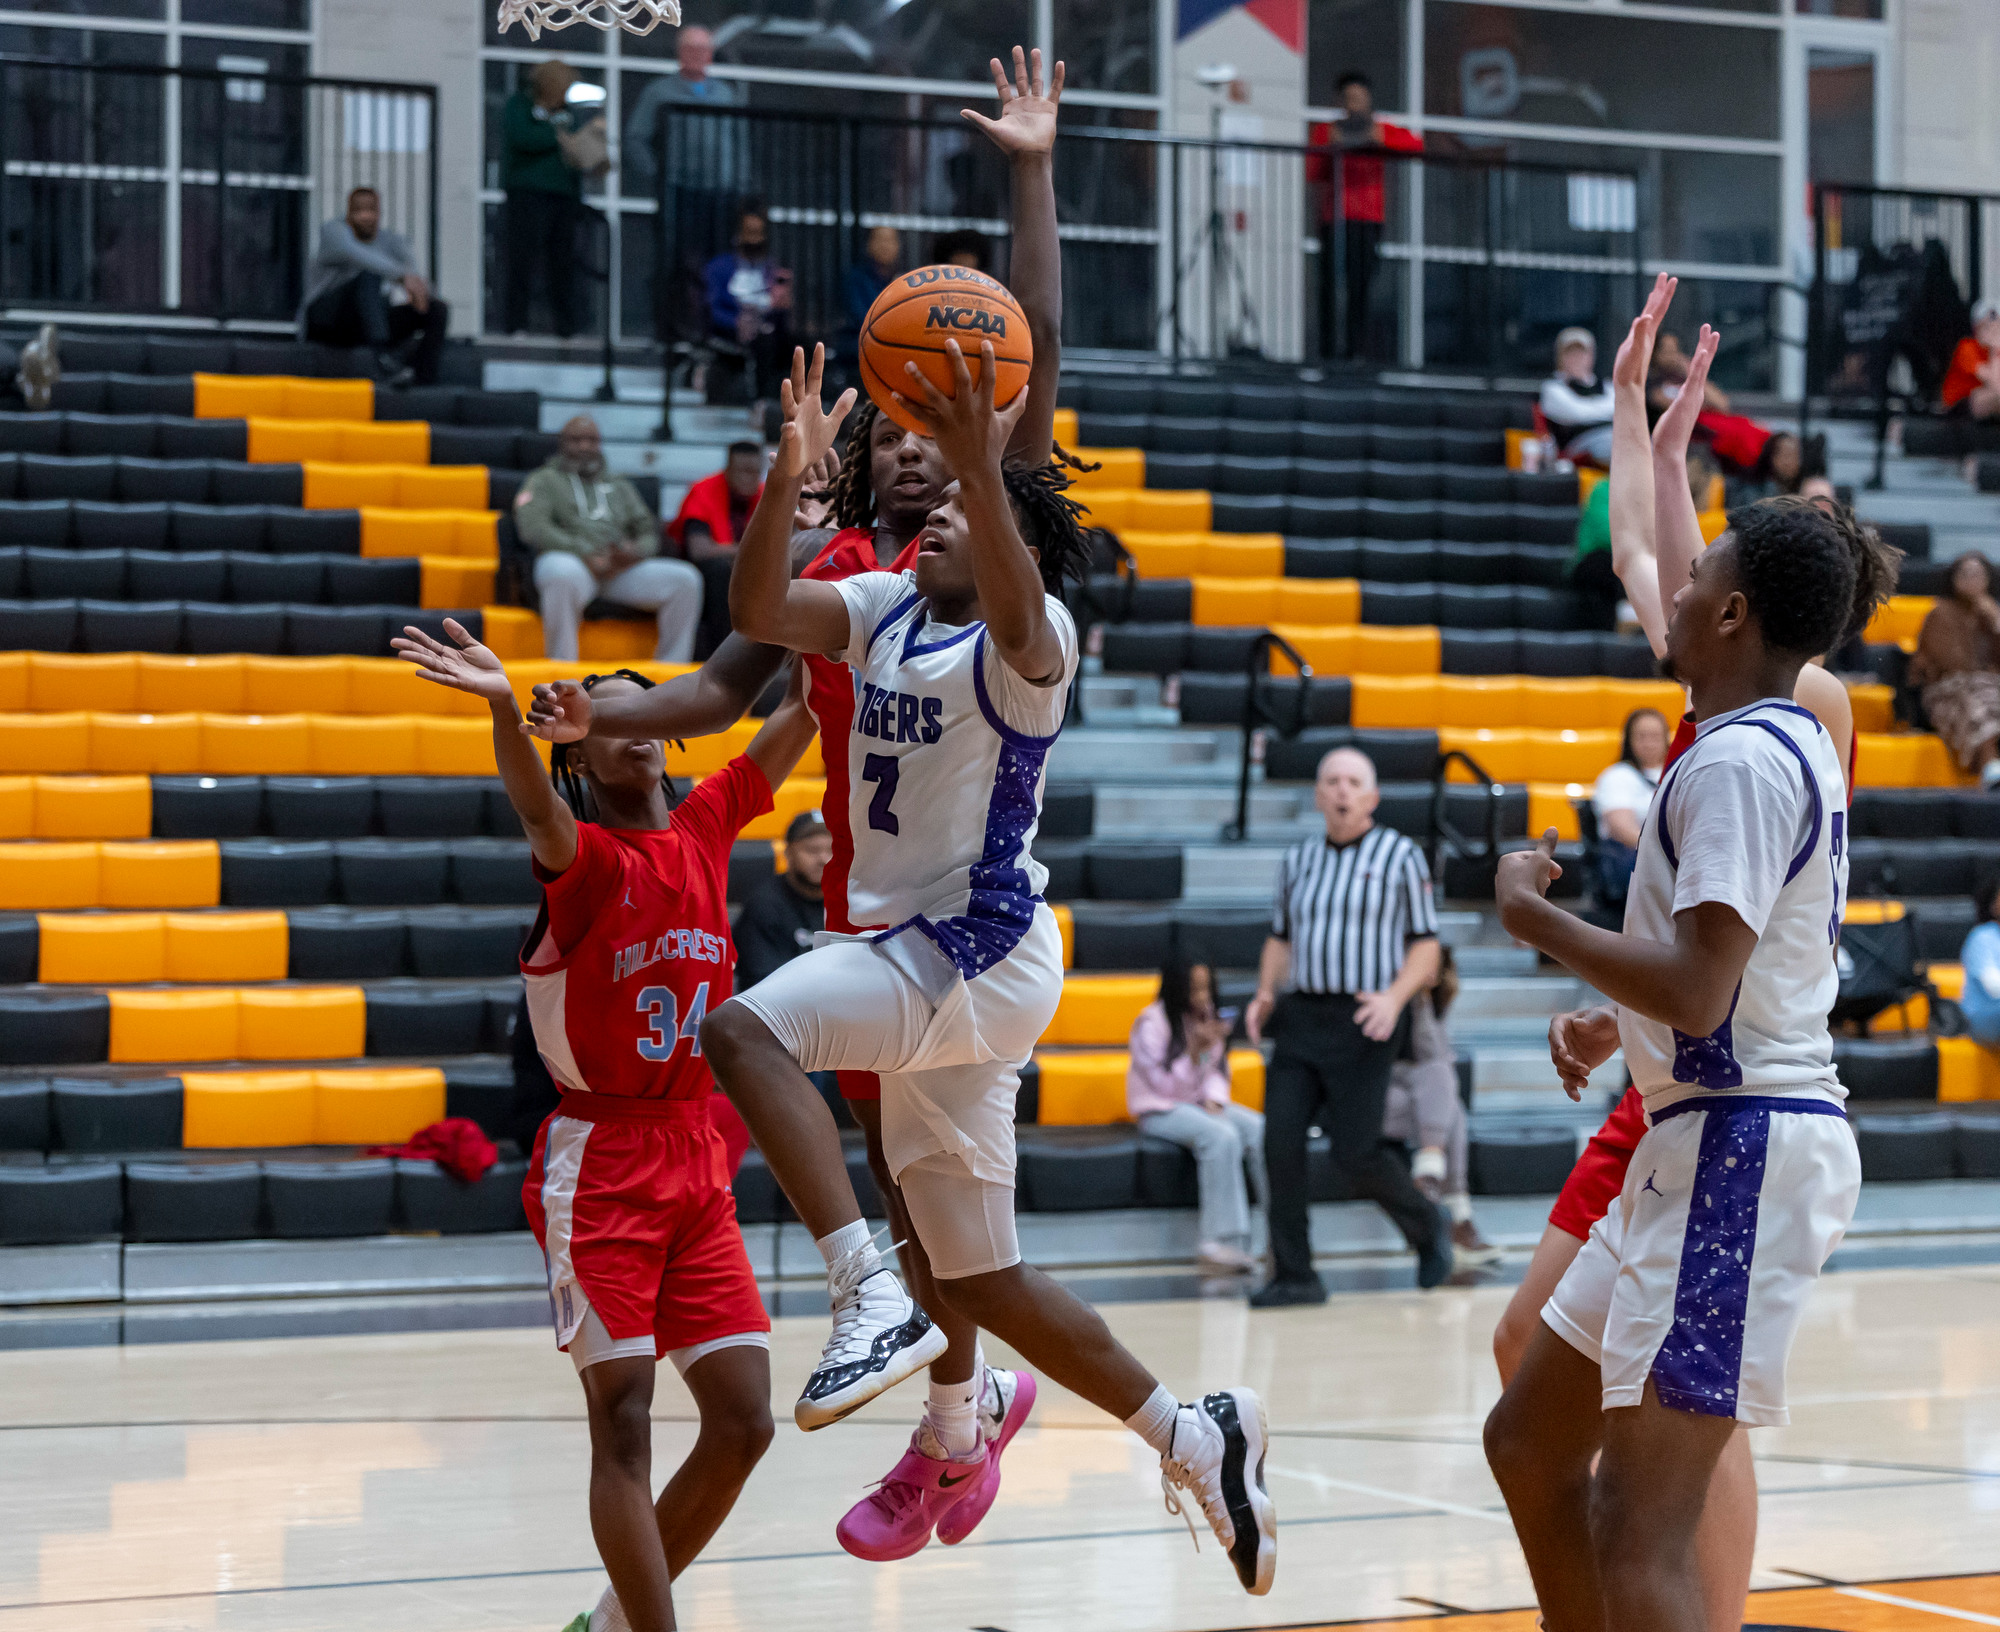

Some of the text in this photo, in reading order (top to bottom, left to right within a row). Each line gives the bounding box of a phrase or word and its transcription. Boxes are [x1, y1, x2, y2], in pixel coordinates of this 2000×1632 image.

[925, 306, 1006, 339] NCAA
[852, 681, 943, 744] IGERS
[862, 752, 900, 837] 2
[613, 928, 727, 983] HILLCREST
[636, 981, 710, 1062] 34
